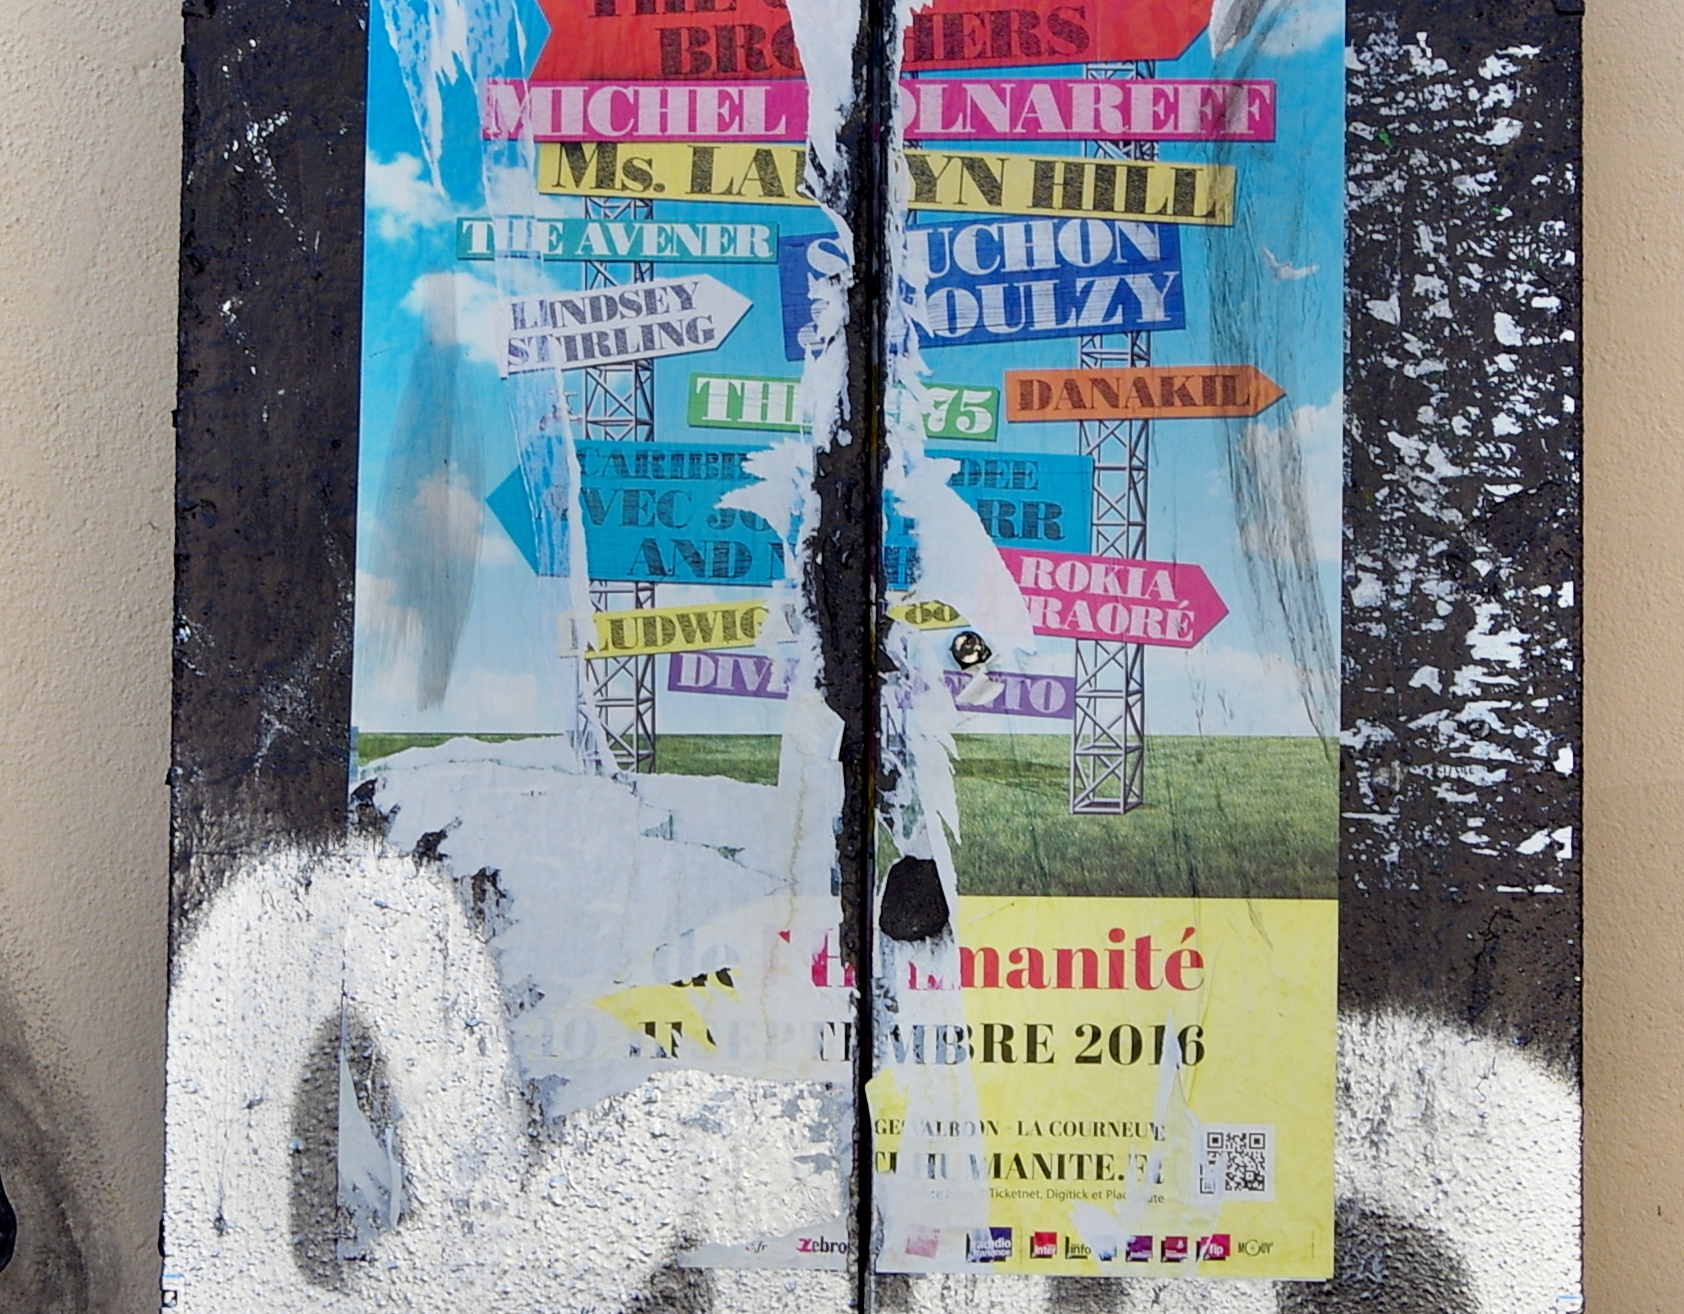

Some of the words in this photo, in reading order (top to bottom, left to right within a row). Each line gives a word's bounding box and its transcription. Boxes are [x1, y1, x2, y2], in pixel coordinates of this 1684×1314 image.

[486, 82, 786, 137] MICHEL
[1027, 158, 1217, 219] HILL
[575, 222, 774, 259] AVENER
[510, 282, 701, 331] LINDSEY
[507, 315, 716, 369] STIRLING
[1016, 373, 1252, 412] DANAKIL
[627, 537, 753, 579] AND
[1019, 555, 1177, 602] ROKIA
[1023, 594, 1195, 643] RAORÉ
[1075, 1023, 1206, 1068] 2016
[1017, 1120, 1043, 1137] LA
[1046, 1189, 1088, 1203] Digitick
[1091, 1191, 1102, 1200] et
